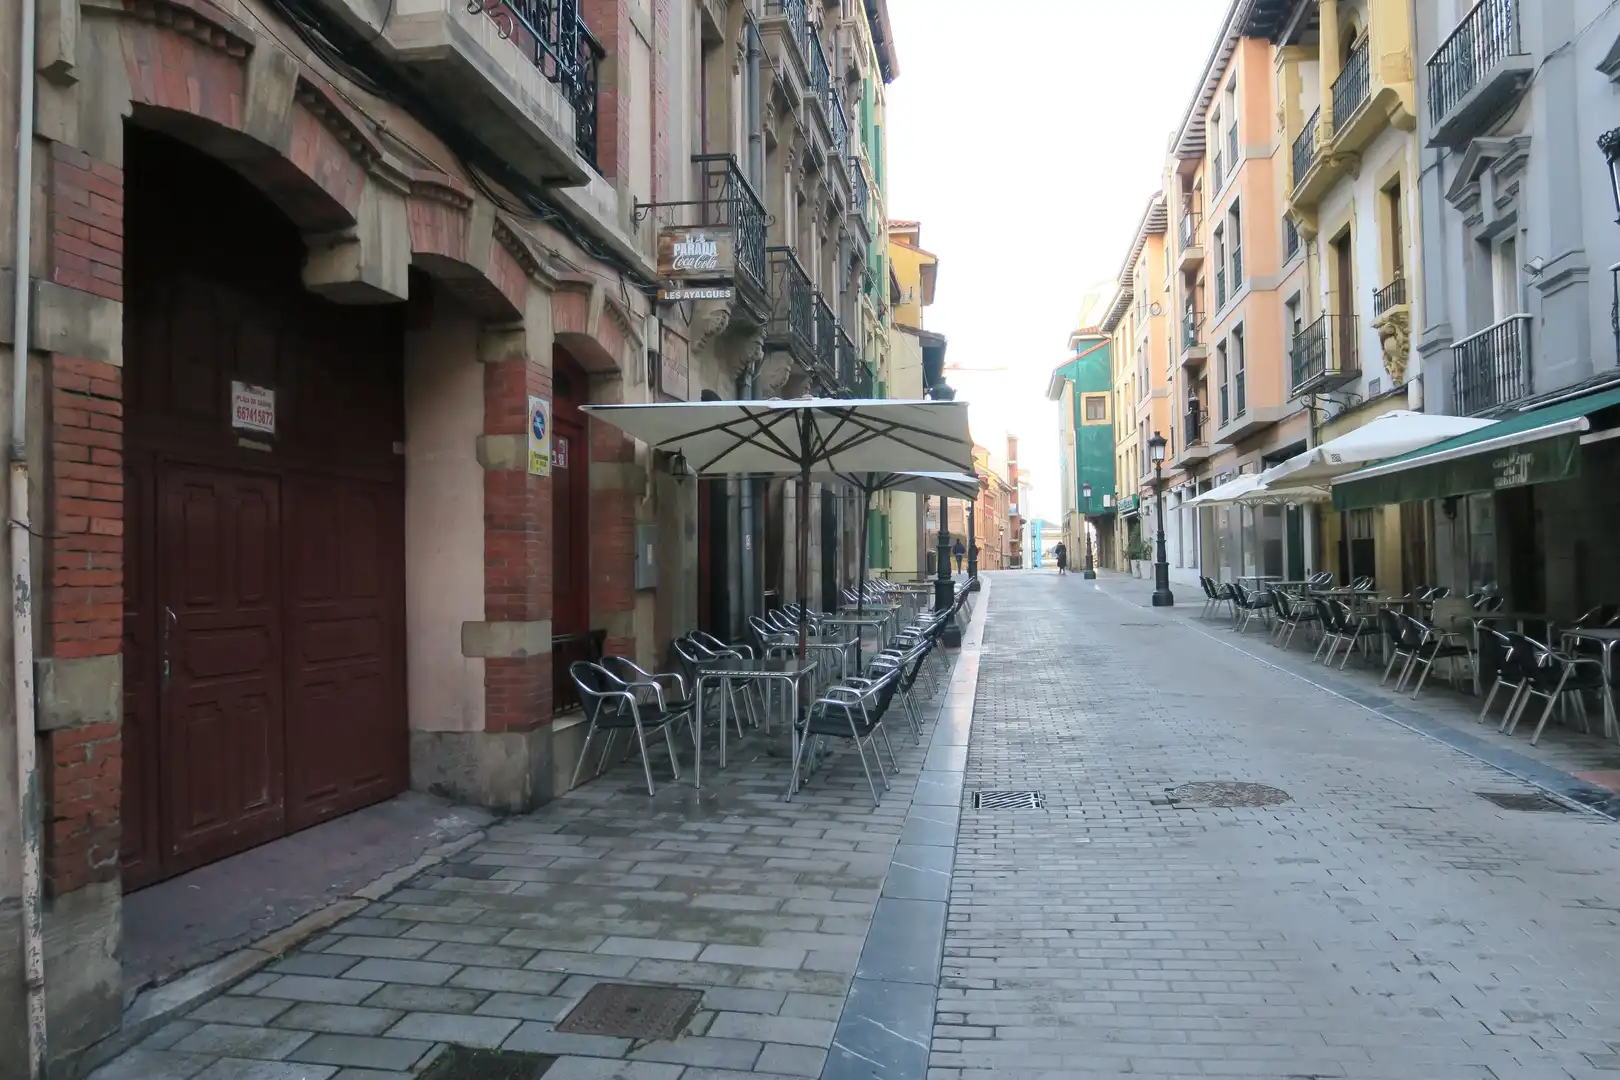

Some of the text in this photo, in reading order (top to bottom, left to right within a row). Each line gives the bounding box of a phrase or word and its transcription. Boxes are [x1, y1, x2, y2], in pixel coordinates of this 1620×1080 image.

[673, 241, 717, 256] PARADA
[664, 290, 731, 300] LES AYALGUES
